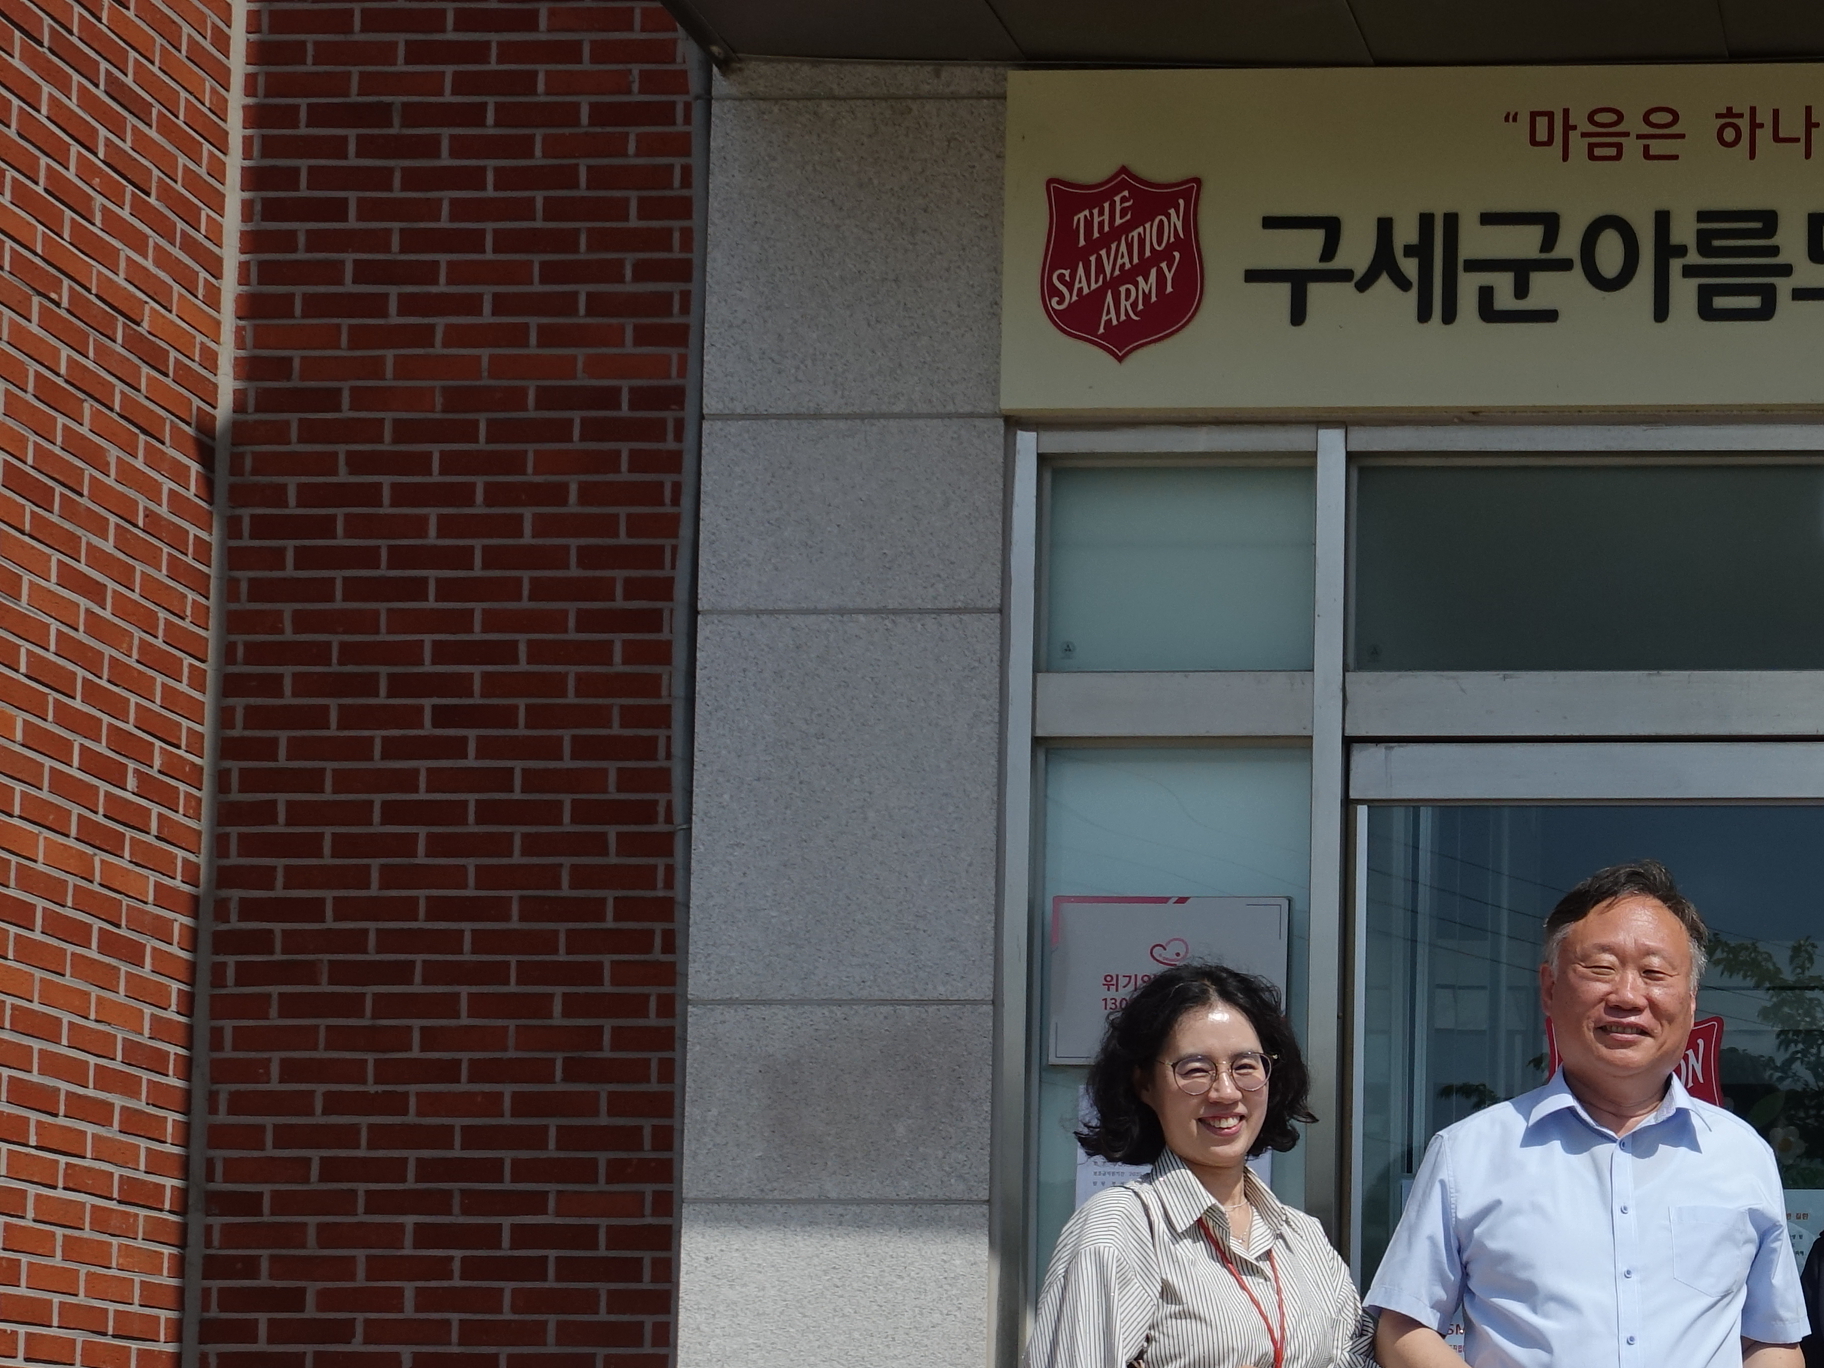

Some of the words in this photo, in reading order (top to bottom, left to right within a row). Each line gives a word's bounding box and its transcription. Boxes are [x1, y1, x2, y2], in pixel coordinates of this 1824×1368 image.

[1503, 105, 1686, 163] “마음은
[1051, 198, 1185, 310] SALVATION
[1073, 190, 1133, 248] THE
[1097, 251, 1181, 335] ARMY
